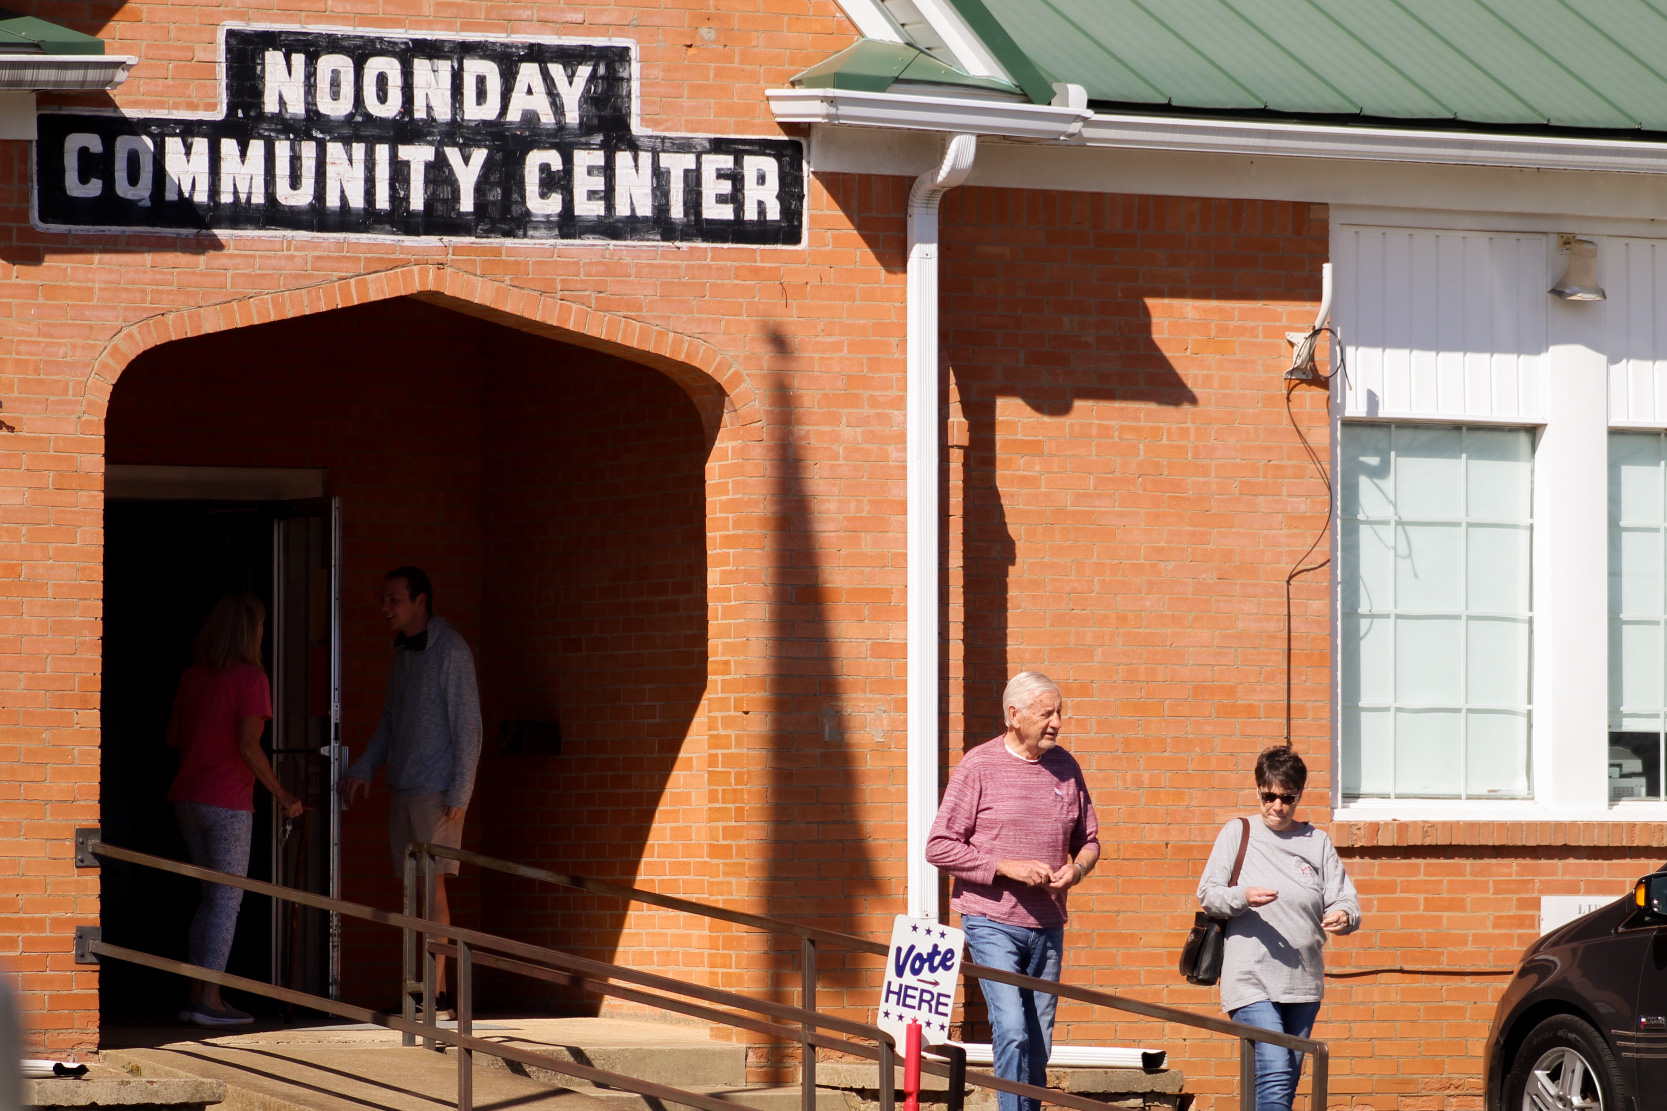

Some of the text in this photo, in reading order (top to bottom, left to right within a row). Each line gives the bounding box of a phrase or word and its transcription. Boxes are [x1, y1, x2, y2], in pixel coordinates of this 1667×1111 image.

[264, 50, 594, 123] NOONDAY
[64, 133, 781, 220] COMMUNITY CENTER
[894, 943, 955, 978] Vote
[884, 980, 951, 1017] HERE
